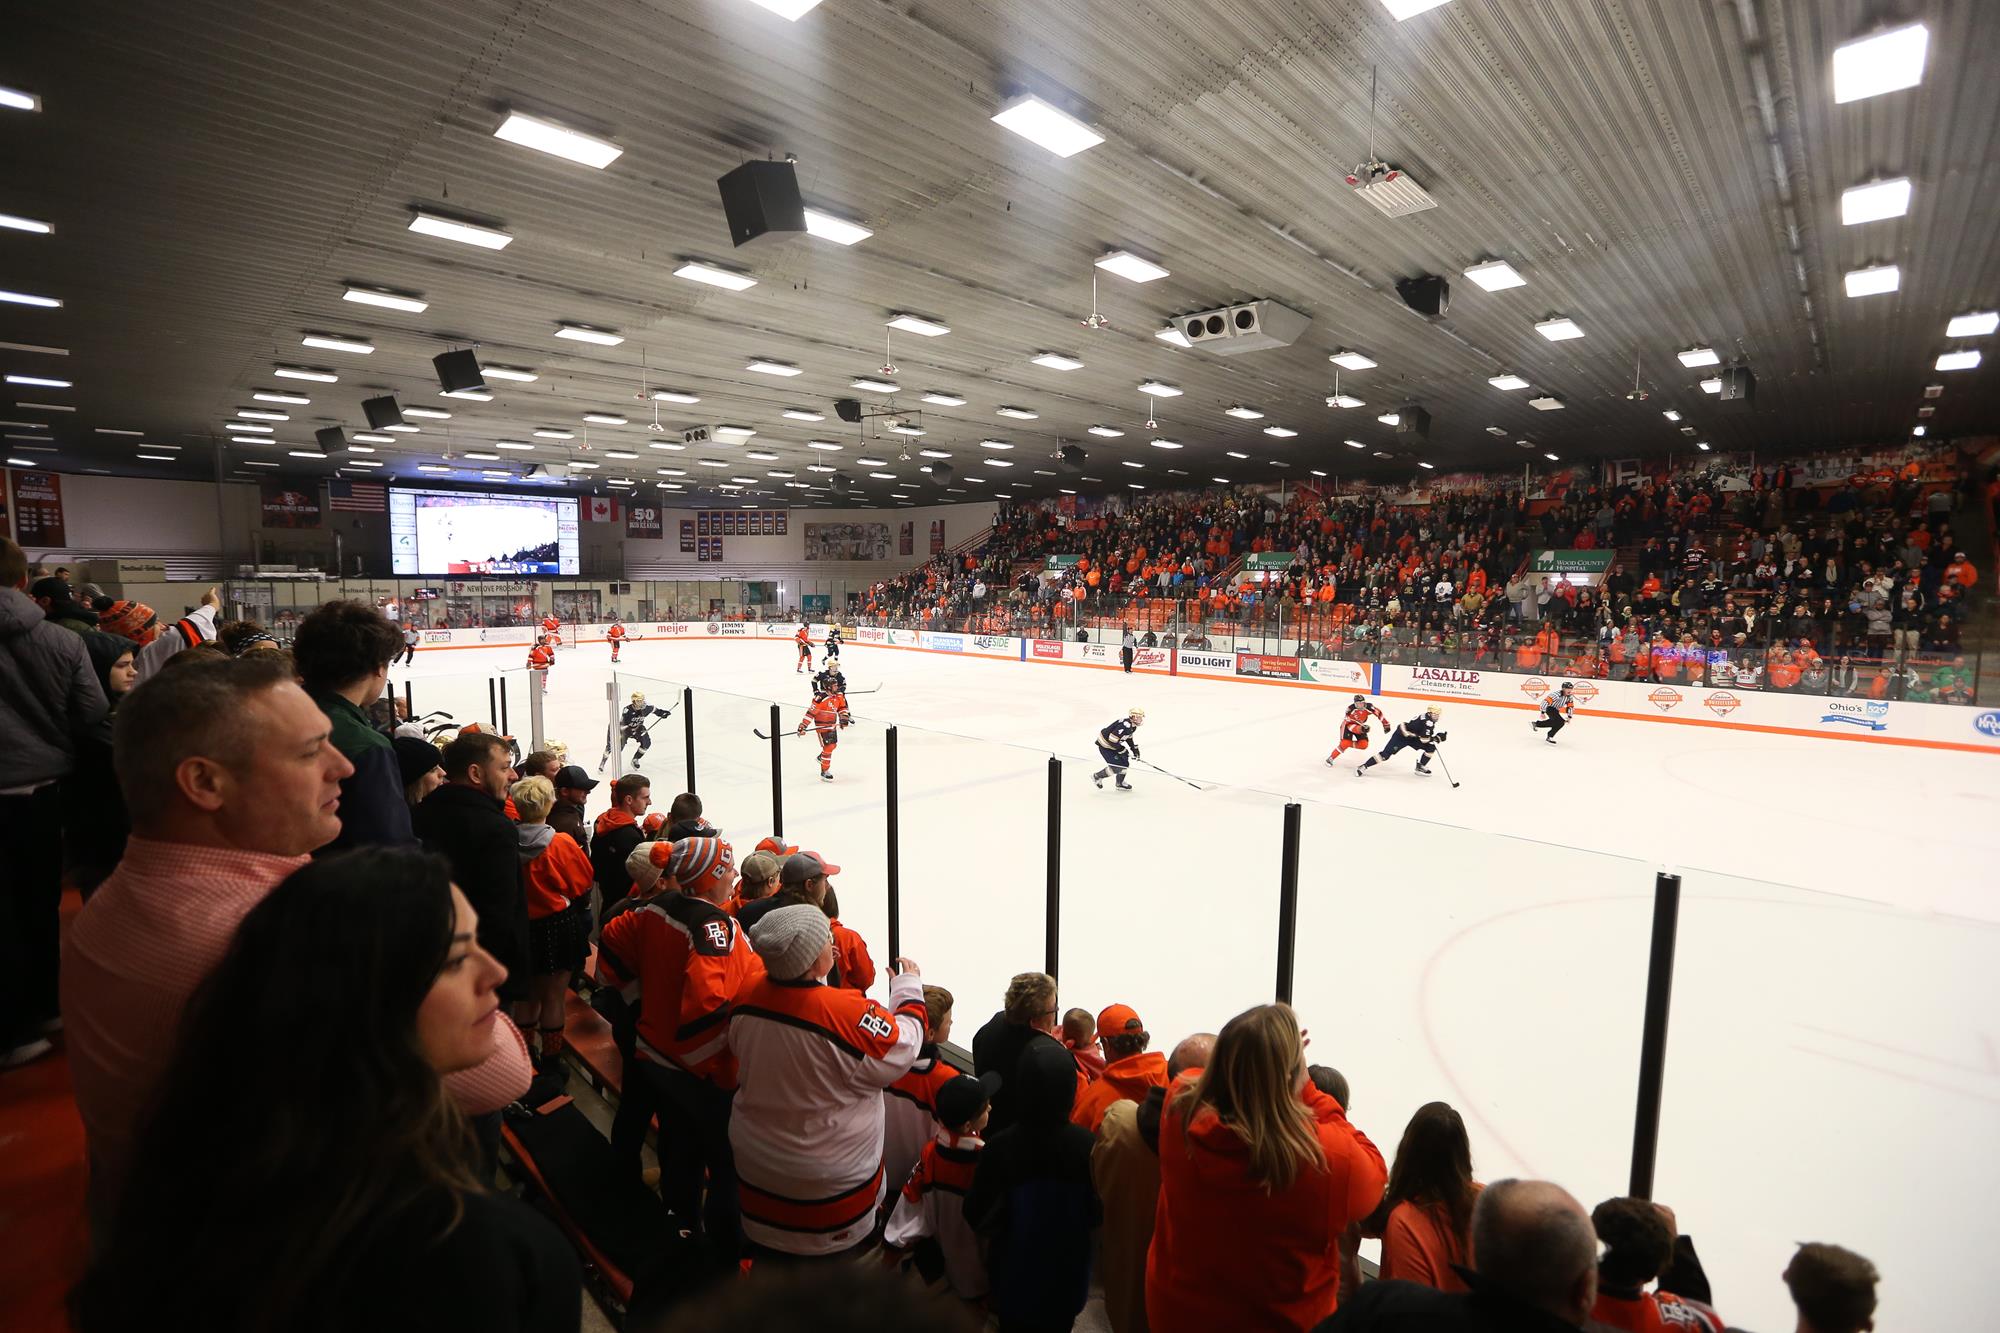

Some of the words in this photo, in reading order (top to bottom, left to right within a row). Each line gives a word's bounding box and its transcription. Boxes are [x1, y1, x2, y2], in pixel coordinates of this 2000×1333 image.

[634, 508, 655, 520] 50
[467, 585, 495, 593] NEWOVE
[657, 622, 689, 635] meijer
[859, 628, 885, 641] meijer
[973, 635, 1010, 648] LAKESIDE
[1133, 648, 1166, 663] Fricker's
[1181, 655, 1202, 666] BUD
[1202, 657, 1232, 668] LIGHT
[1412, 668, 1480, 684] LASALLE
[1421, 680, 1457, 689] Cleaners,
[1829, 702, 1863, 713] Ohio's
[1868, 705, 1887, 714] 529
